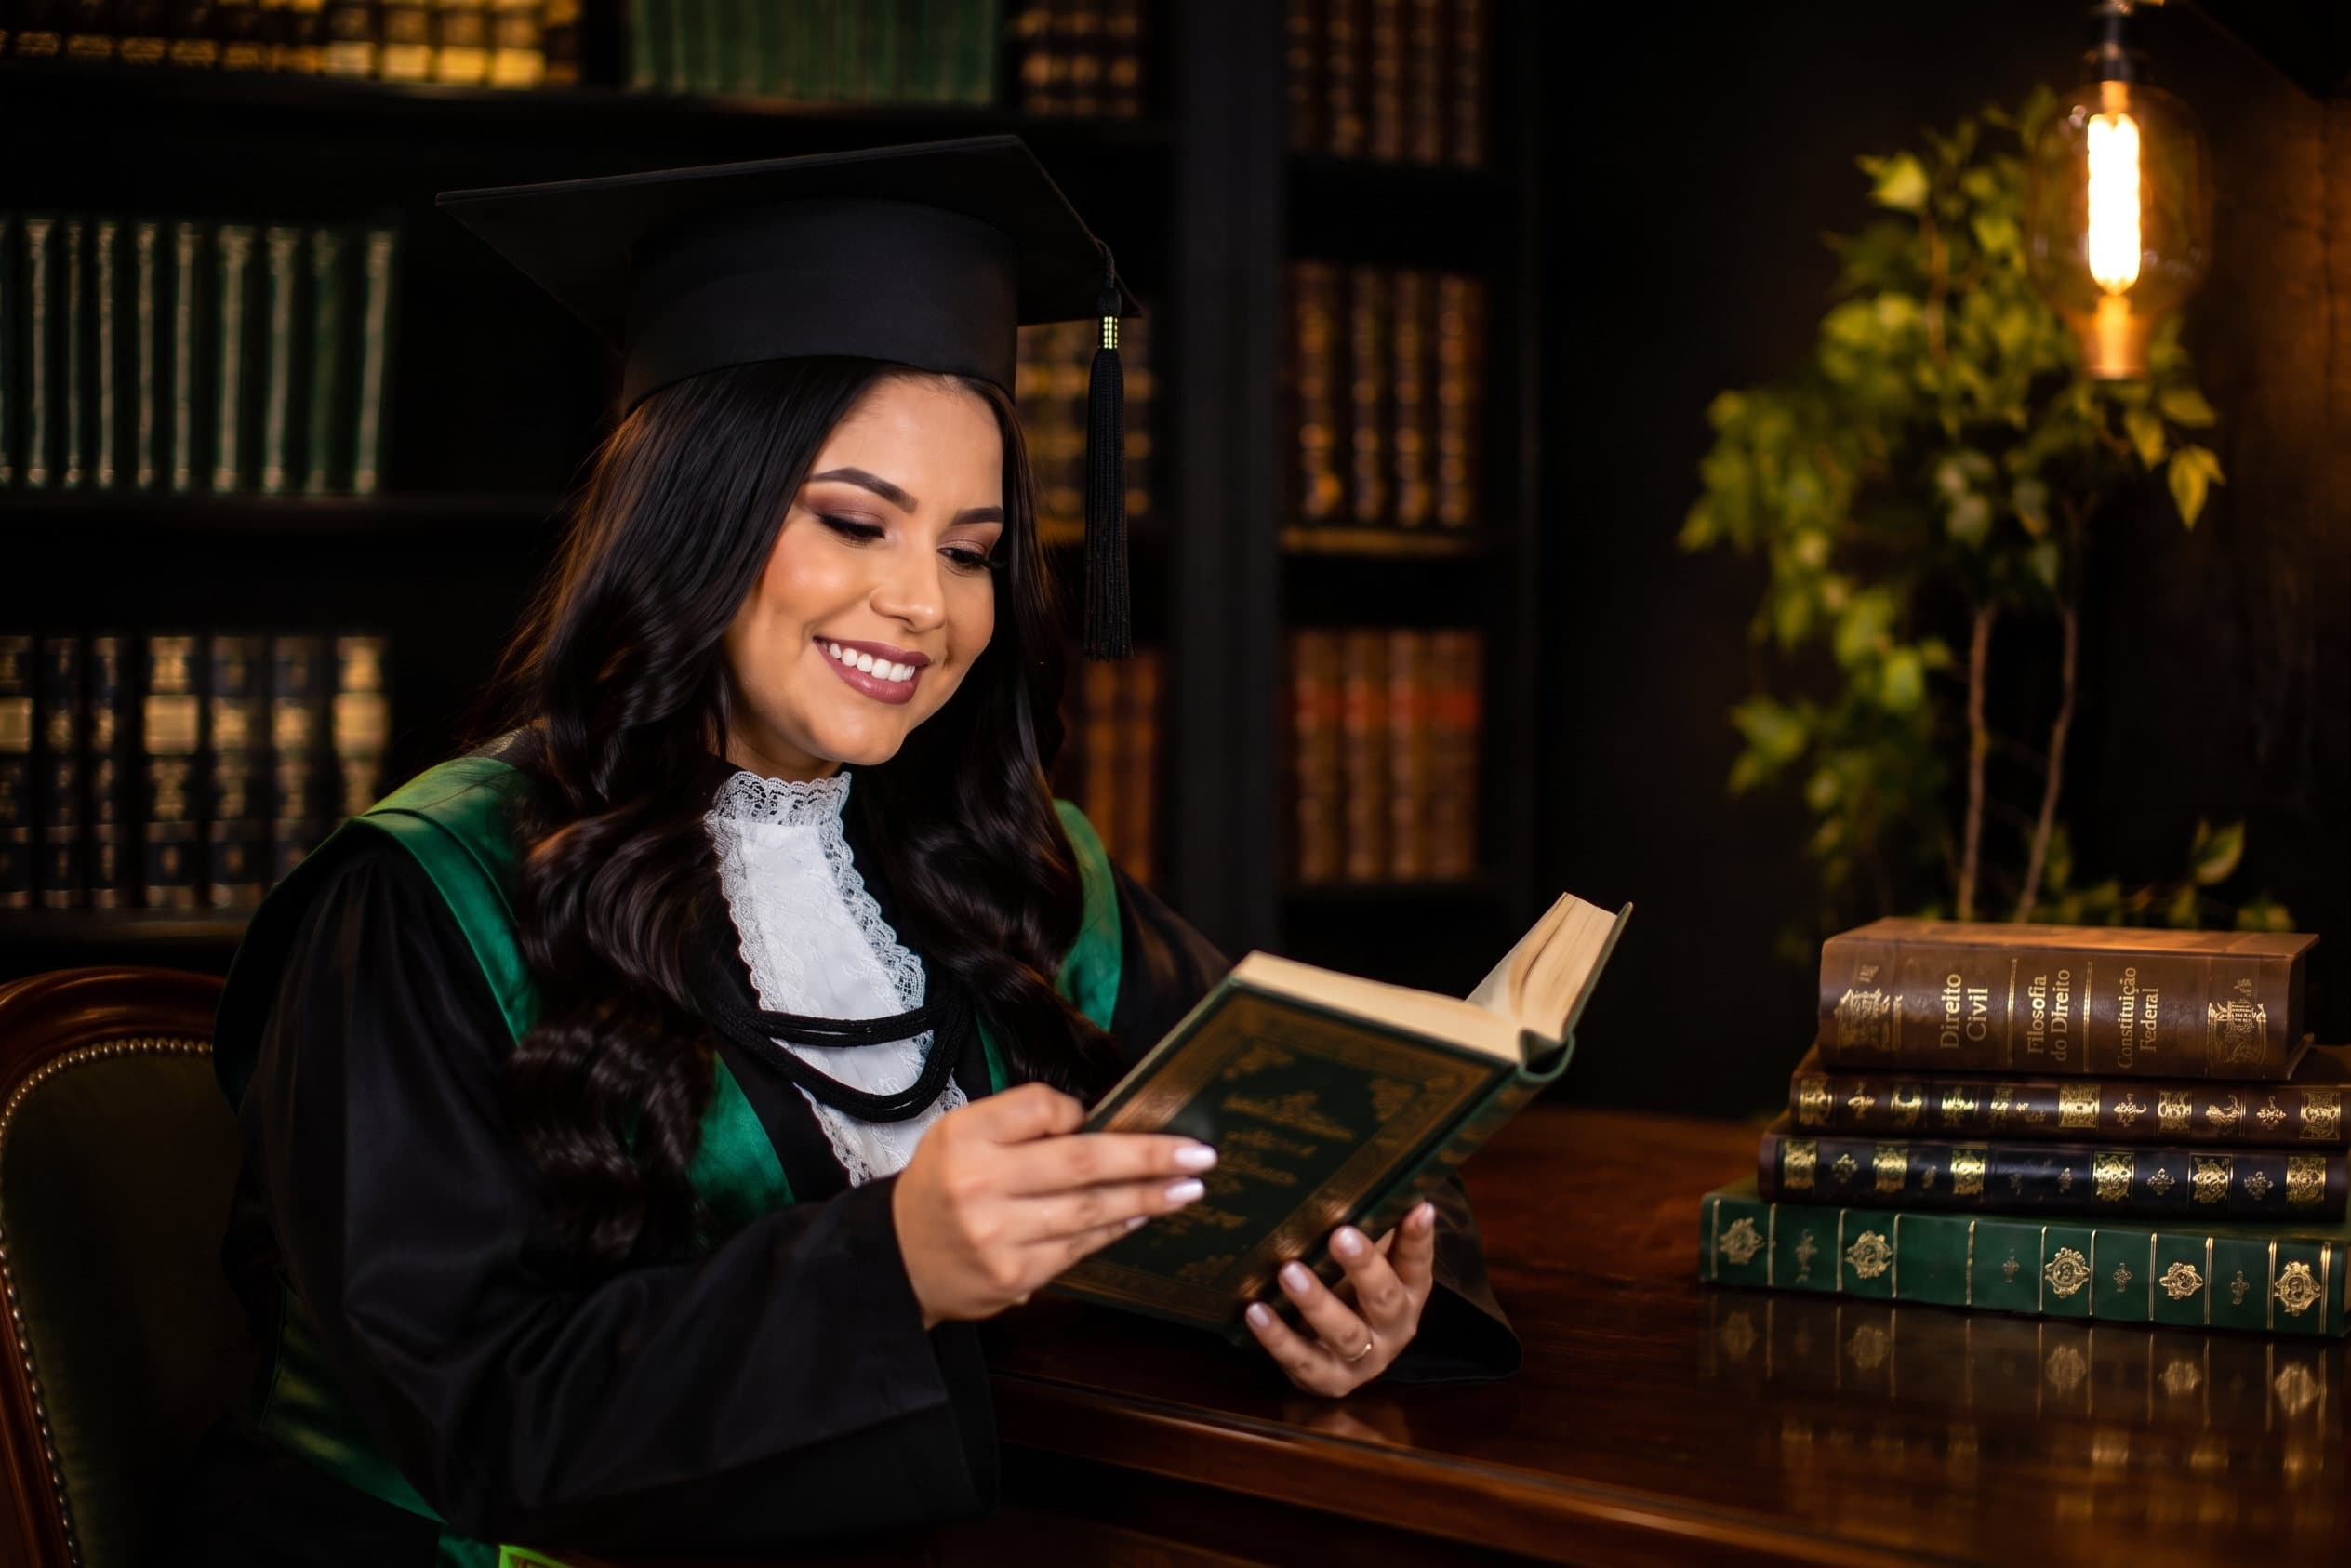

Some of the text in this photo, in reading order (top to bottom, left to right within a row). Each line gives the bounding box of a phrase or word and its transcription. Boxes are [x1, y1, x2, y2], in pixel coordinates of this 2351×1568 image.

[1940, 974, 1962, 1049] Direito
[1967, 988, 1988, 1041] Civil
[2027, 974, 2047, 1055] Filosofia
[2117, 967, 2139, 1069] Constituição
[2140, 988, 2158, 1053] Federal
[2050, 1039, 2067, 1062] do
